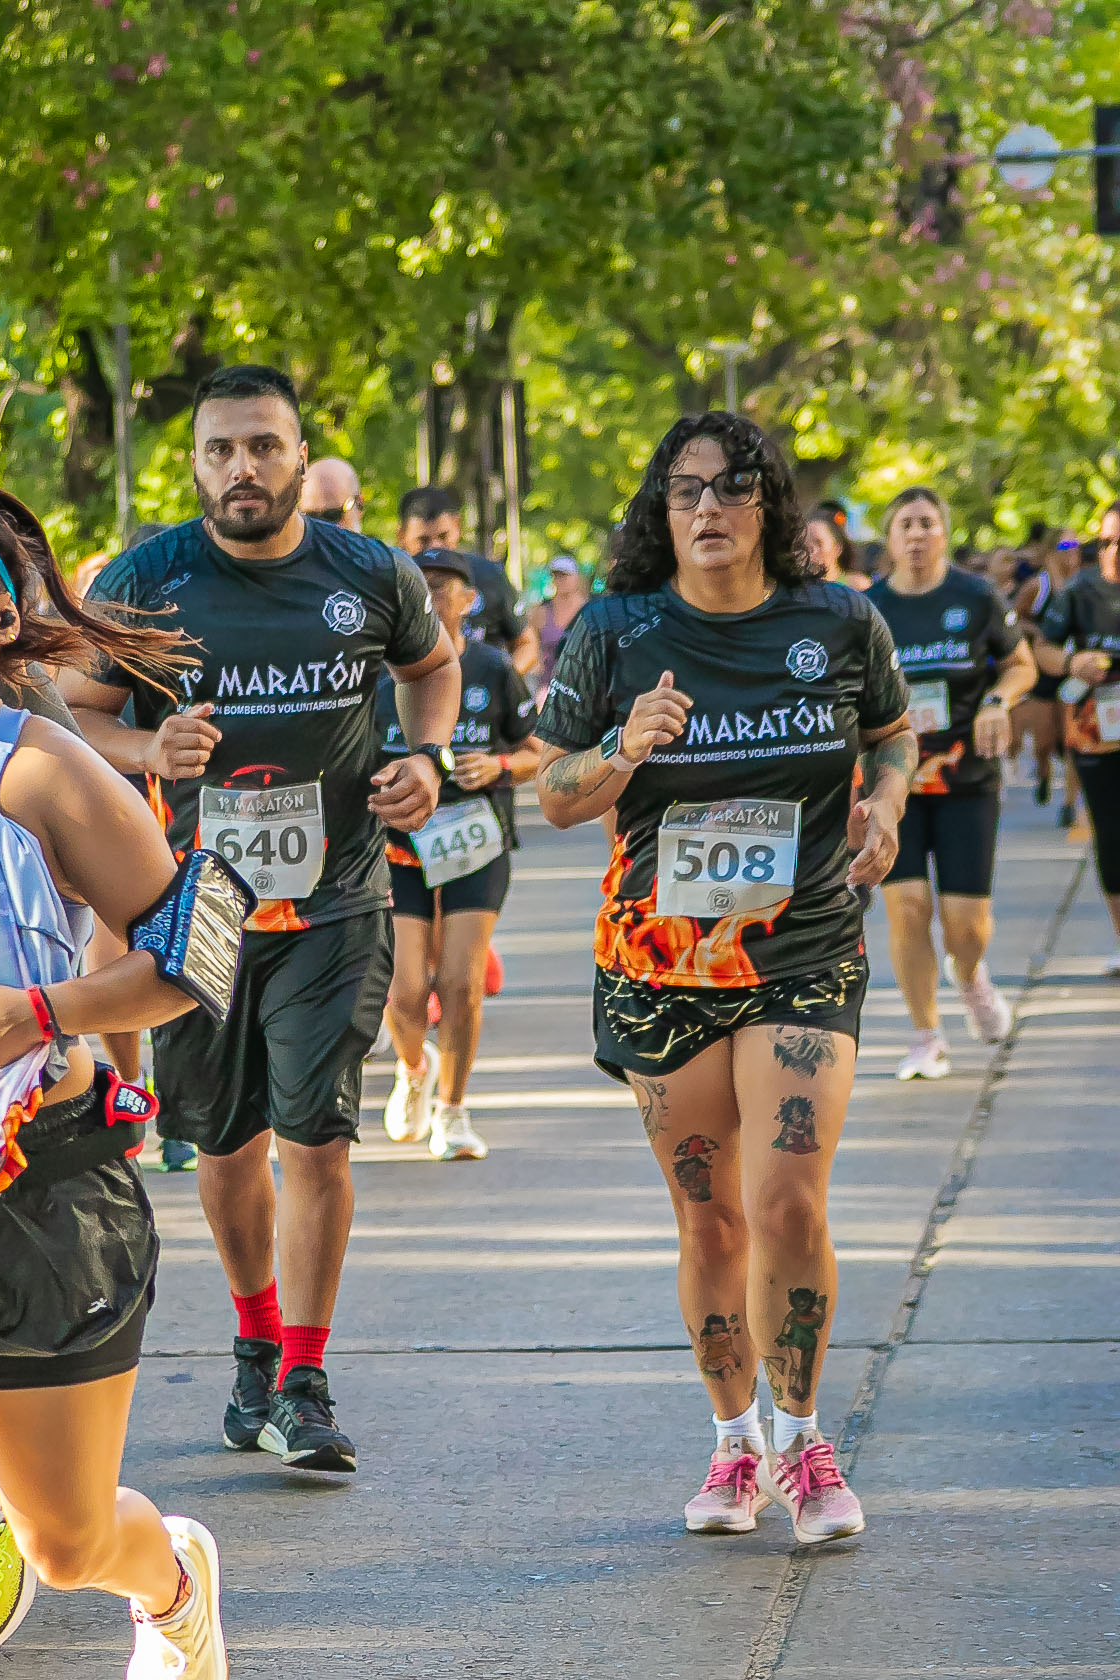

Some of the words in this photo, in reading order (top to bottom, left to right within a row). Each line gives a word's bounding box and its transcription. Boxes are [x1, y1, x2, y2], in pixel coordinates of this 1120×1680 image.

[217, 650, 366, 697] MARATÓN
[223, 704, 275, 715] BOMBEROS
[277, 700, 337, 714] VOLUNTARIOS
[686, 697, 835, 746] MARATÓN
[693, 749, 747, 763] BOMBEROS
[747, 743, 812, 759] VOLUNTARIOS
[234, 791, 304, 812] MARATÓN
[699, 804, 780, 826] MARATÓN
[216, 826, 308, 866] 640
[430, 823, 488, 862] 449
[673, 839, 776, 883] 508
